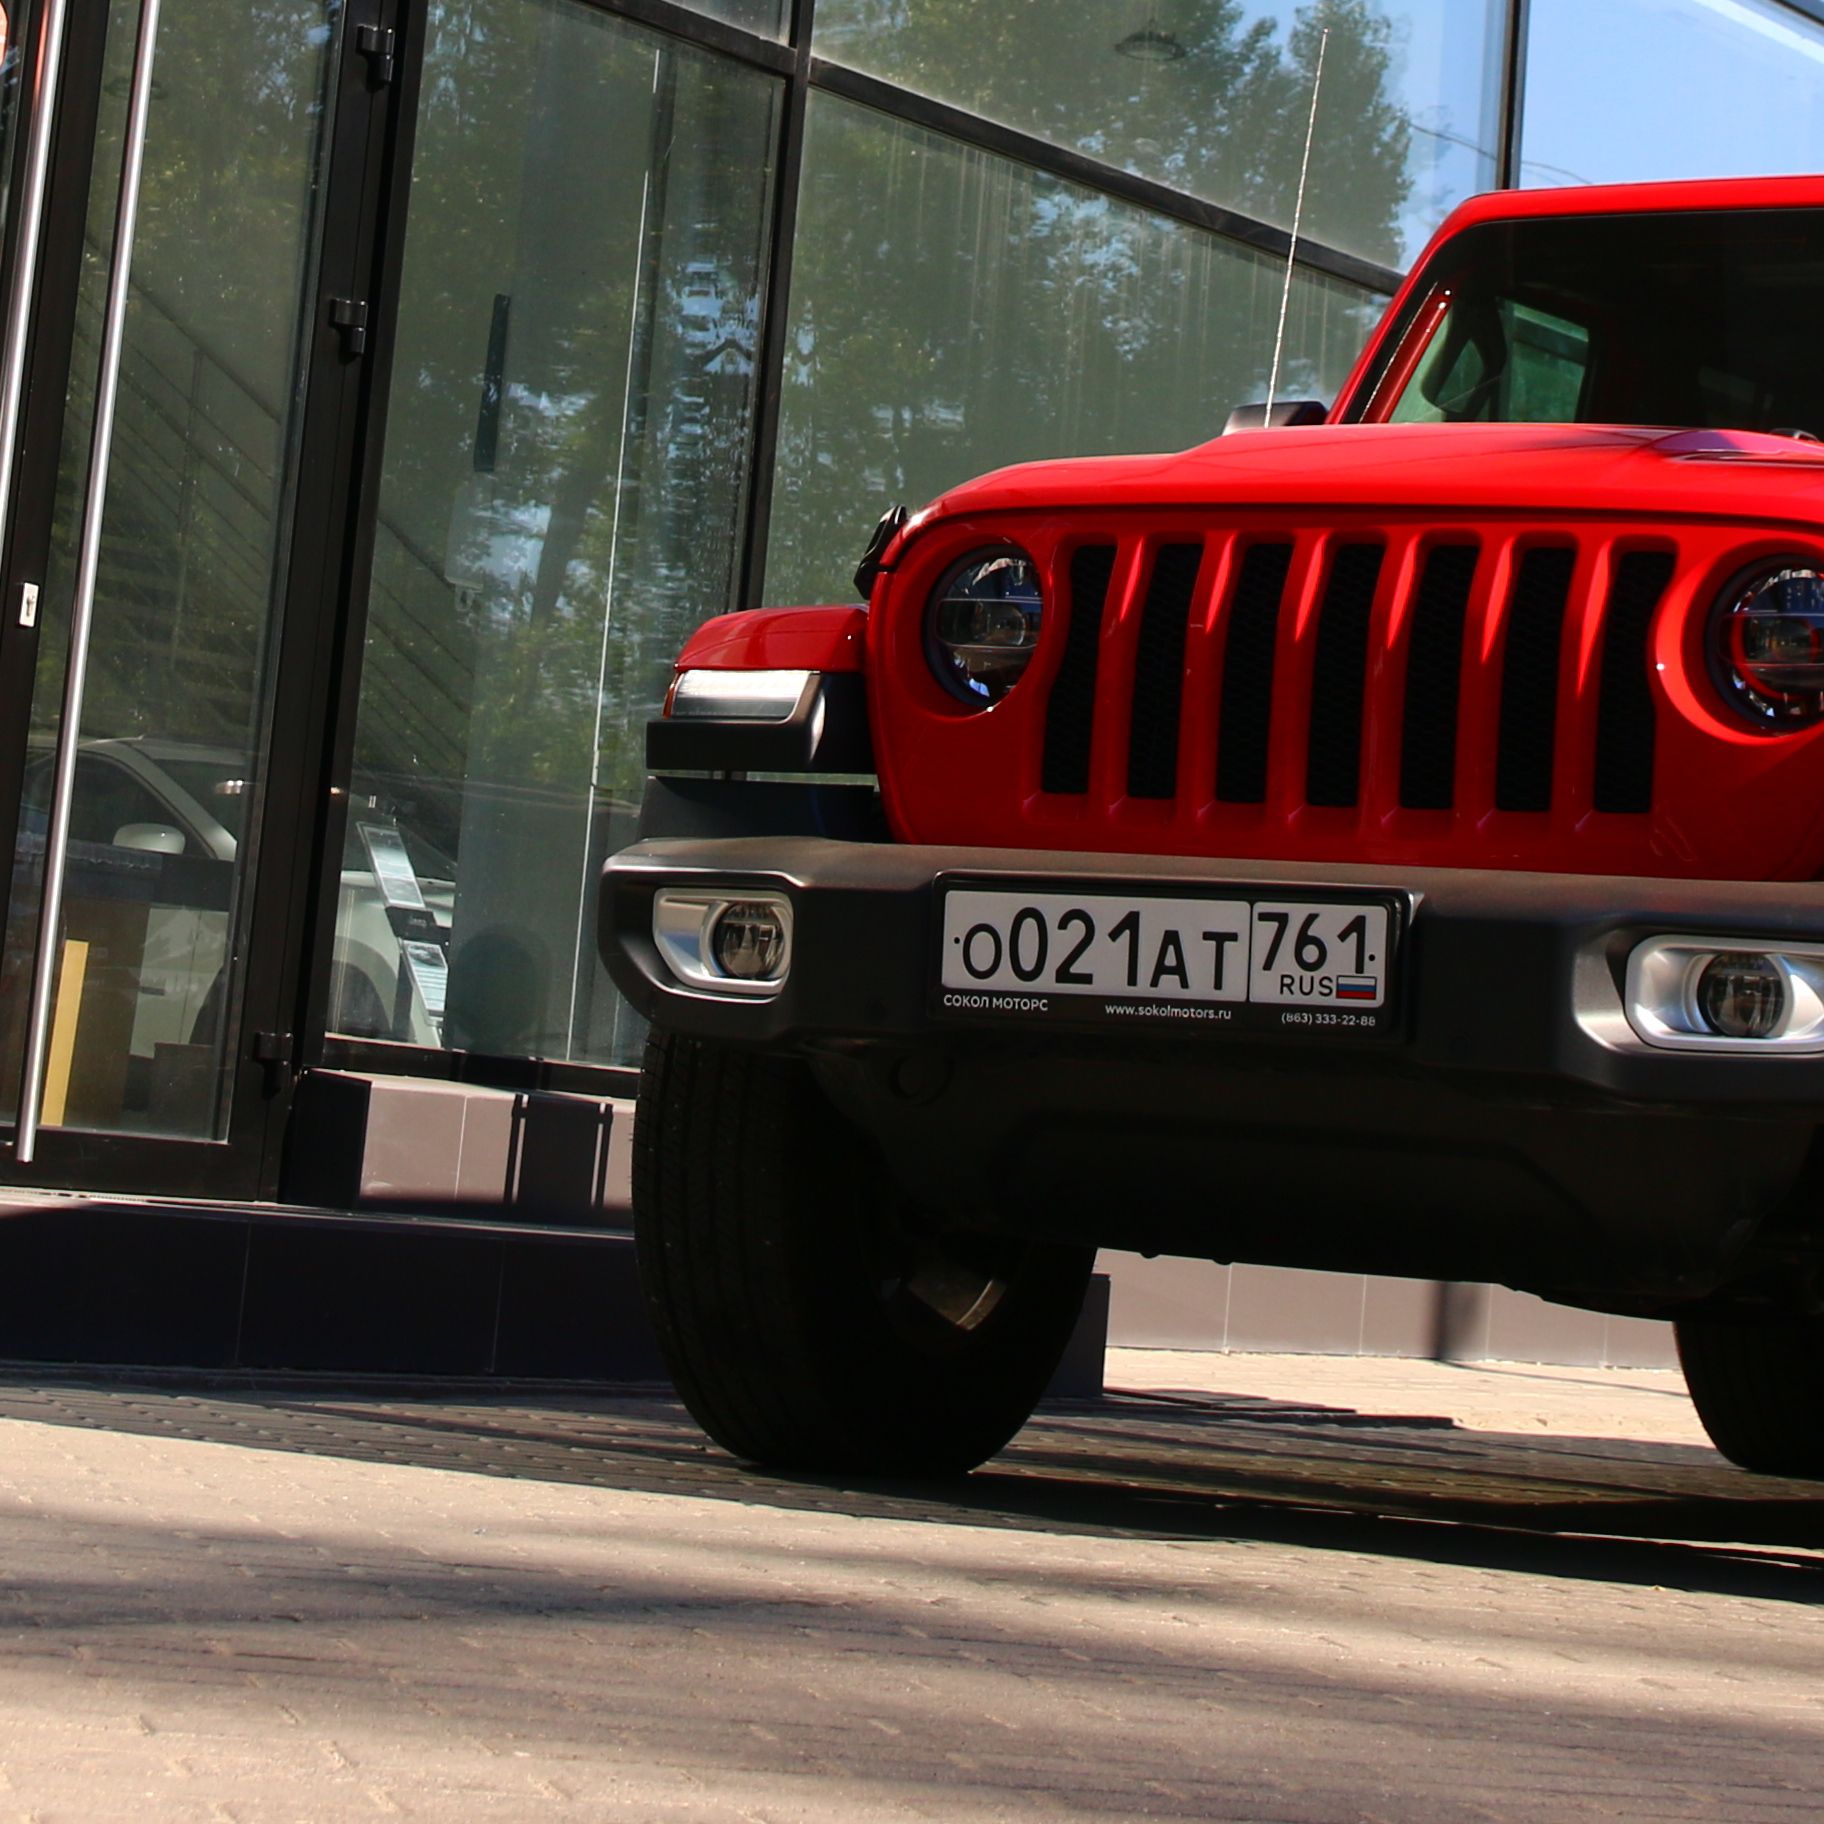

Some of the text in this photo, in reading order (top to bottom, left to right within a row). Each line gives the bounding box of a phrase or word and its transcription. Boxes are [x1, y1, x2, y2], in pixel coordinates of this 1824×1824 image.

[1258, 912, 1367, 974] 761
[1280, 975, 1333, 997] RUS
[943, 994, 1048, 1011] СОКОЛ МОТОРС
[1105, 1003, 1232, 1020] www.sokolmotors.ru
[1281, 1012, 1376, 1026] (863) 333-22-88
